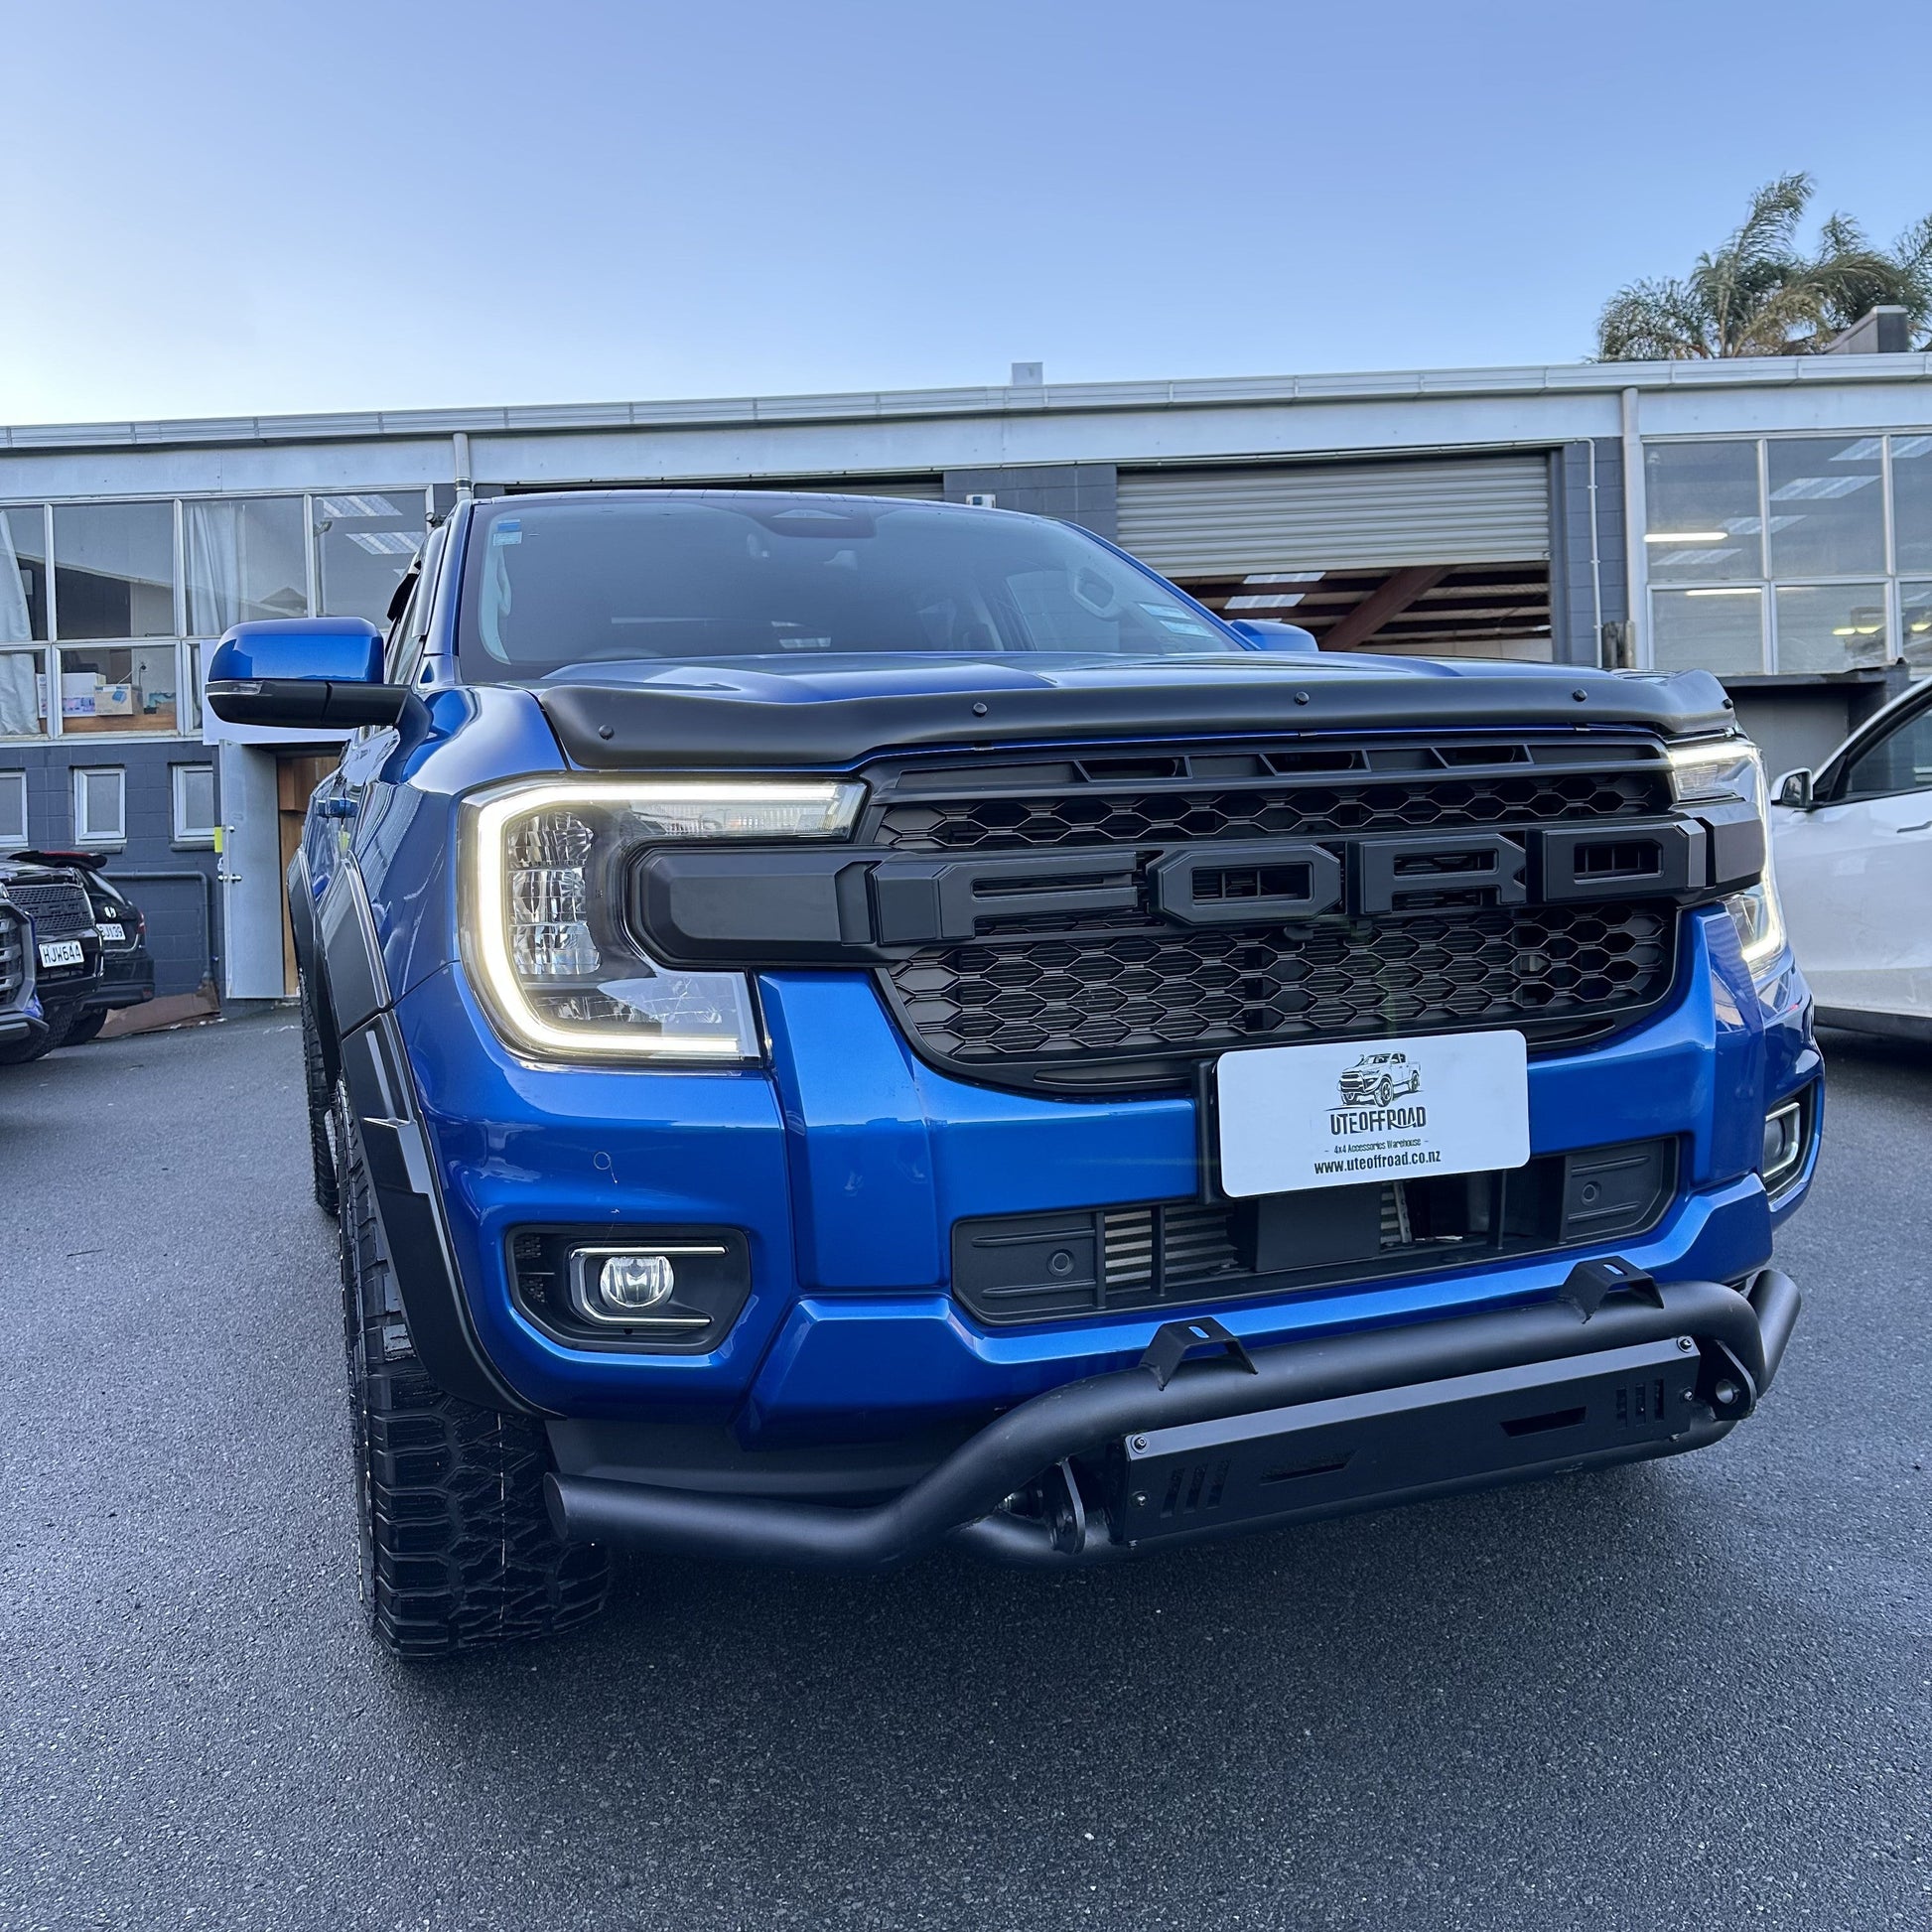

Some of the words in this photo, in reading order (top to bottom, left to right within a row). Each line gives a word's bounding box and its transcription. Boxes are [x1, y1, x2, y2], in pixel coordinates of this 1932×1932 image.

[938, 821, 1692, 939] FORD
[43, 944, 81, 963] HJW644
[1330, 1106, 1427, 1136] UTEOFFROAD
[1333, 1145, 1347, 1154] 4x4
[1347, 1142, 1386, 1153] Accessories
[1387, 1138, 1422, 1149] Warehouse
[1313, 1151, 1442, 1174] www.uteoffroad.co.nz
